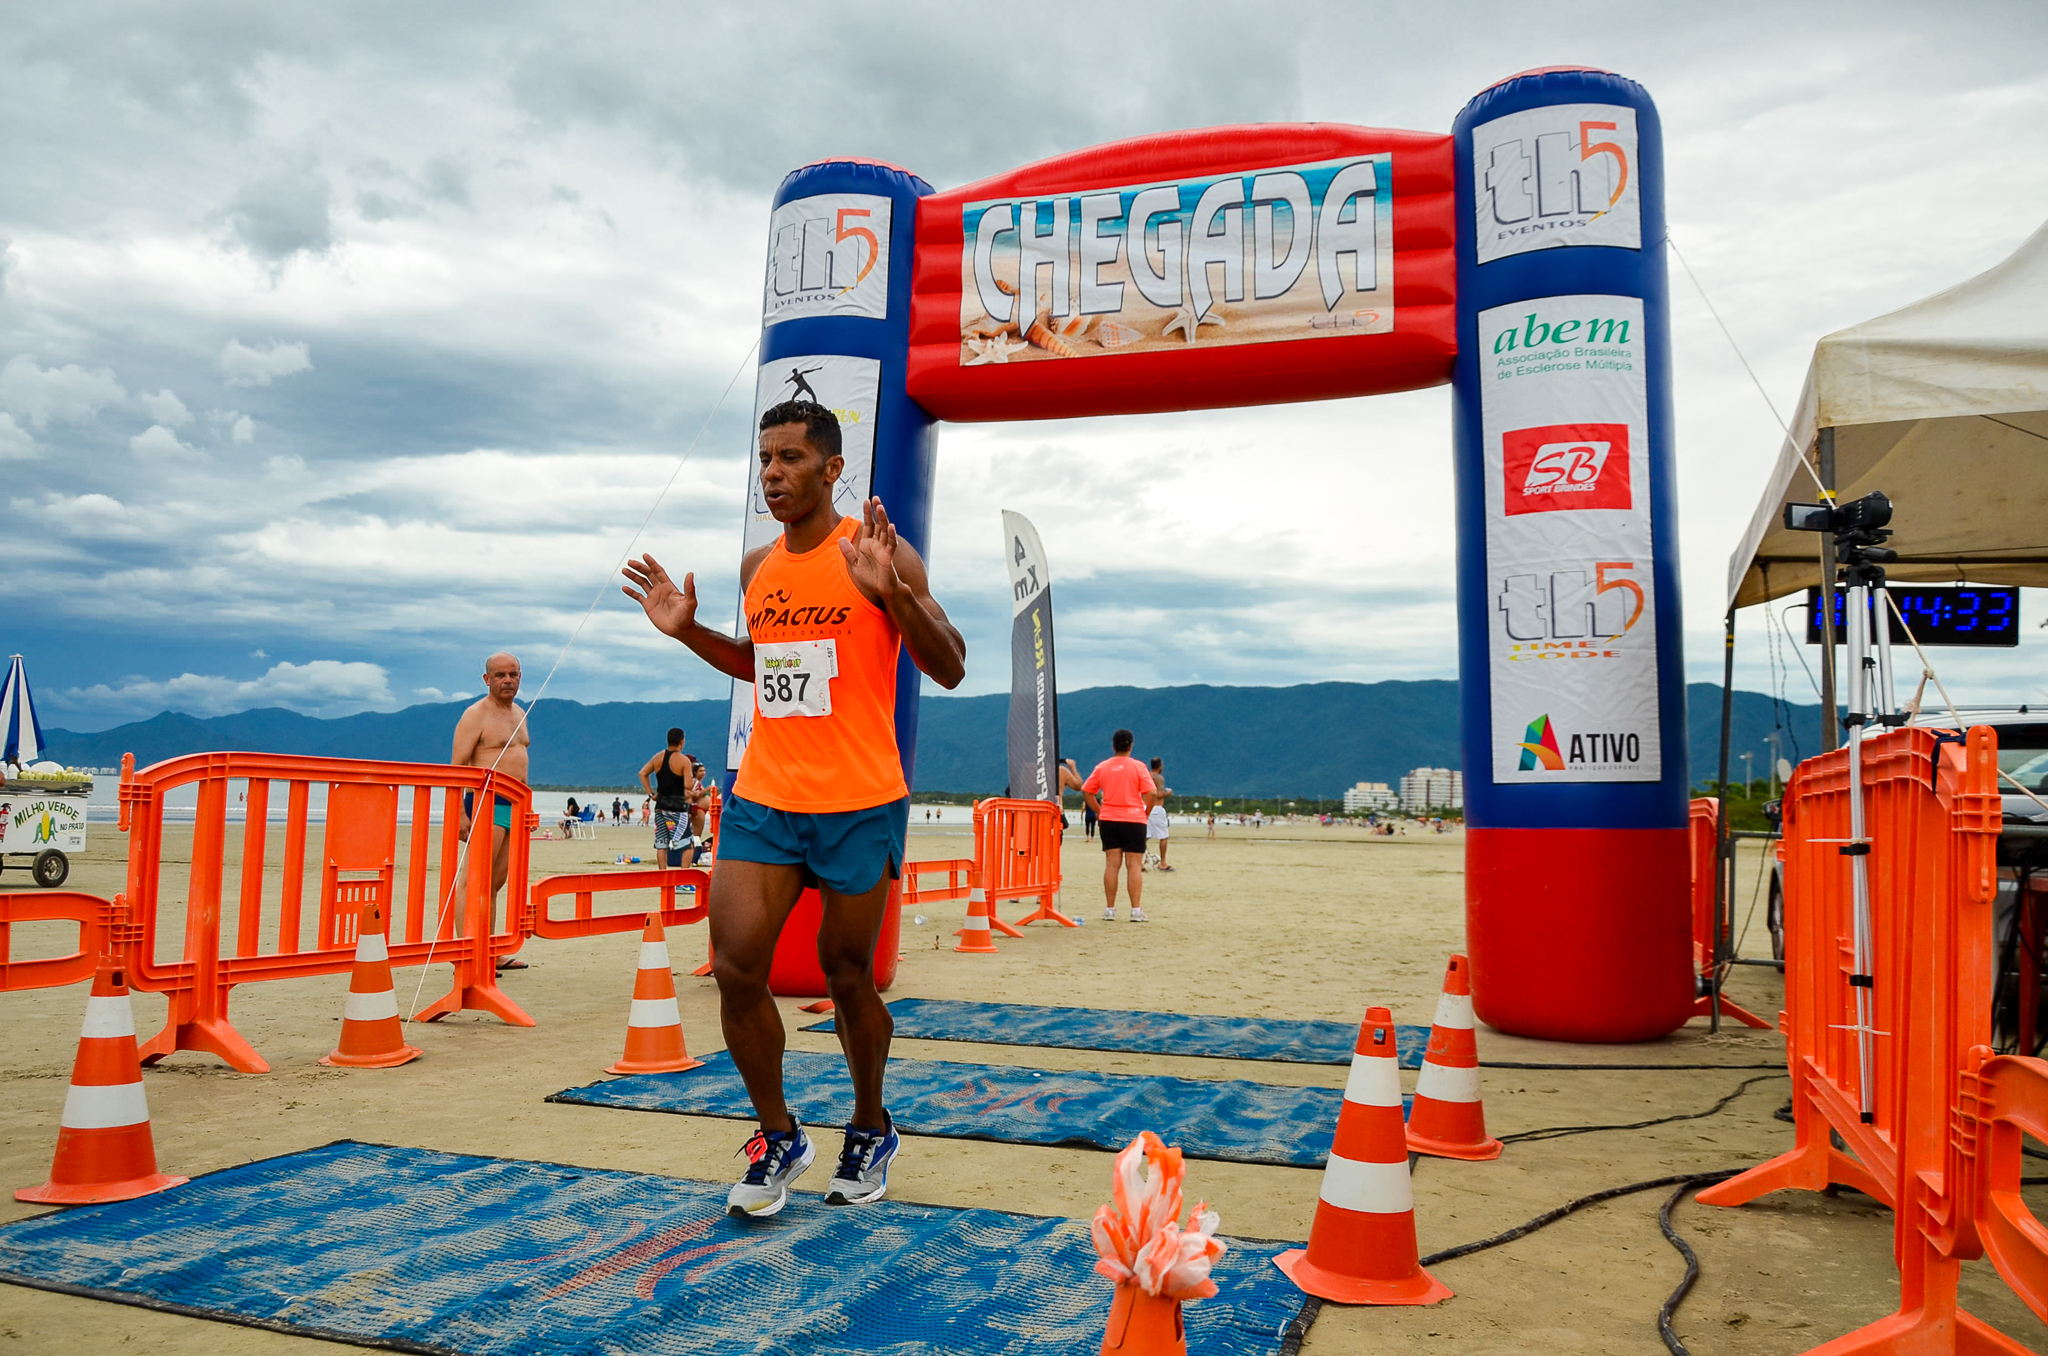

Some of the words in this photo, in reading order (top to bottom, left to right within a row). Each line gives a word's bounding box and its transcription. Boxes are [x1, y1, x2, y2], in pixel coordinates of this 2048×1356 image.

[1498, 219, 1587, 240] EVENTOS
[974, 160, 1378, 338] CHEGADA
[775, 293, 836, 309] EVENTOS
[1494, 313, 1631, 354] abem
[1497, 348, 1571, 367] Associação
[1574, 346, 1632, 358] Brasileira
[1497, 369, 1512, 380] de
[1516, 361, 1581, 376] Esclerose
[1586, 359, 1632, 371] Múltipla
[1530, 446, 1598, 487] SB
[1522, 485, 1553, 497] SPORT
[1554, 482, 1596, 494] BRINDES
[1507, 641, 1597, 651] TIME
[1508, 650, 1621, 661] CODE
[763, 672, 811, 703] 587
[1569, 732, 1640, 763] ATIVO
[14, 801, 45, 829] MILHO
[47, 800, 80, 821] VERDE
[60, 823, 68, 831] NO
[68, 822, 85, 831] PRATO
